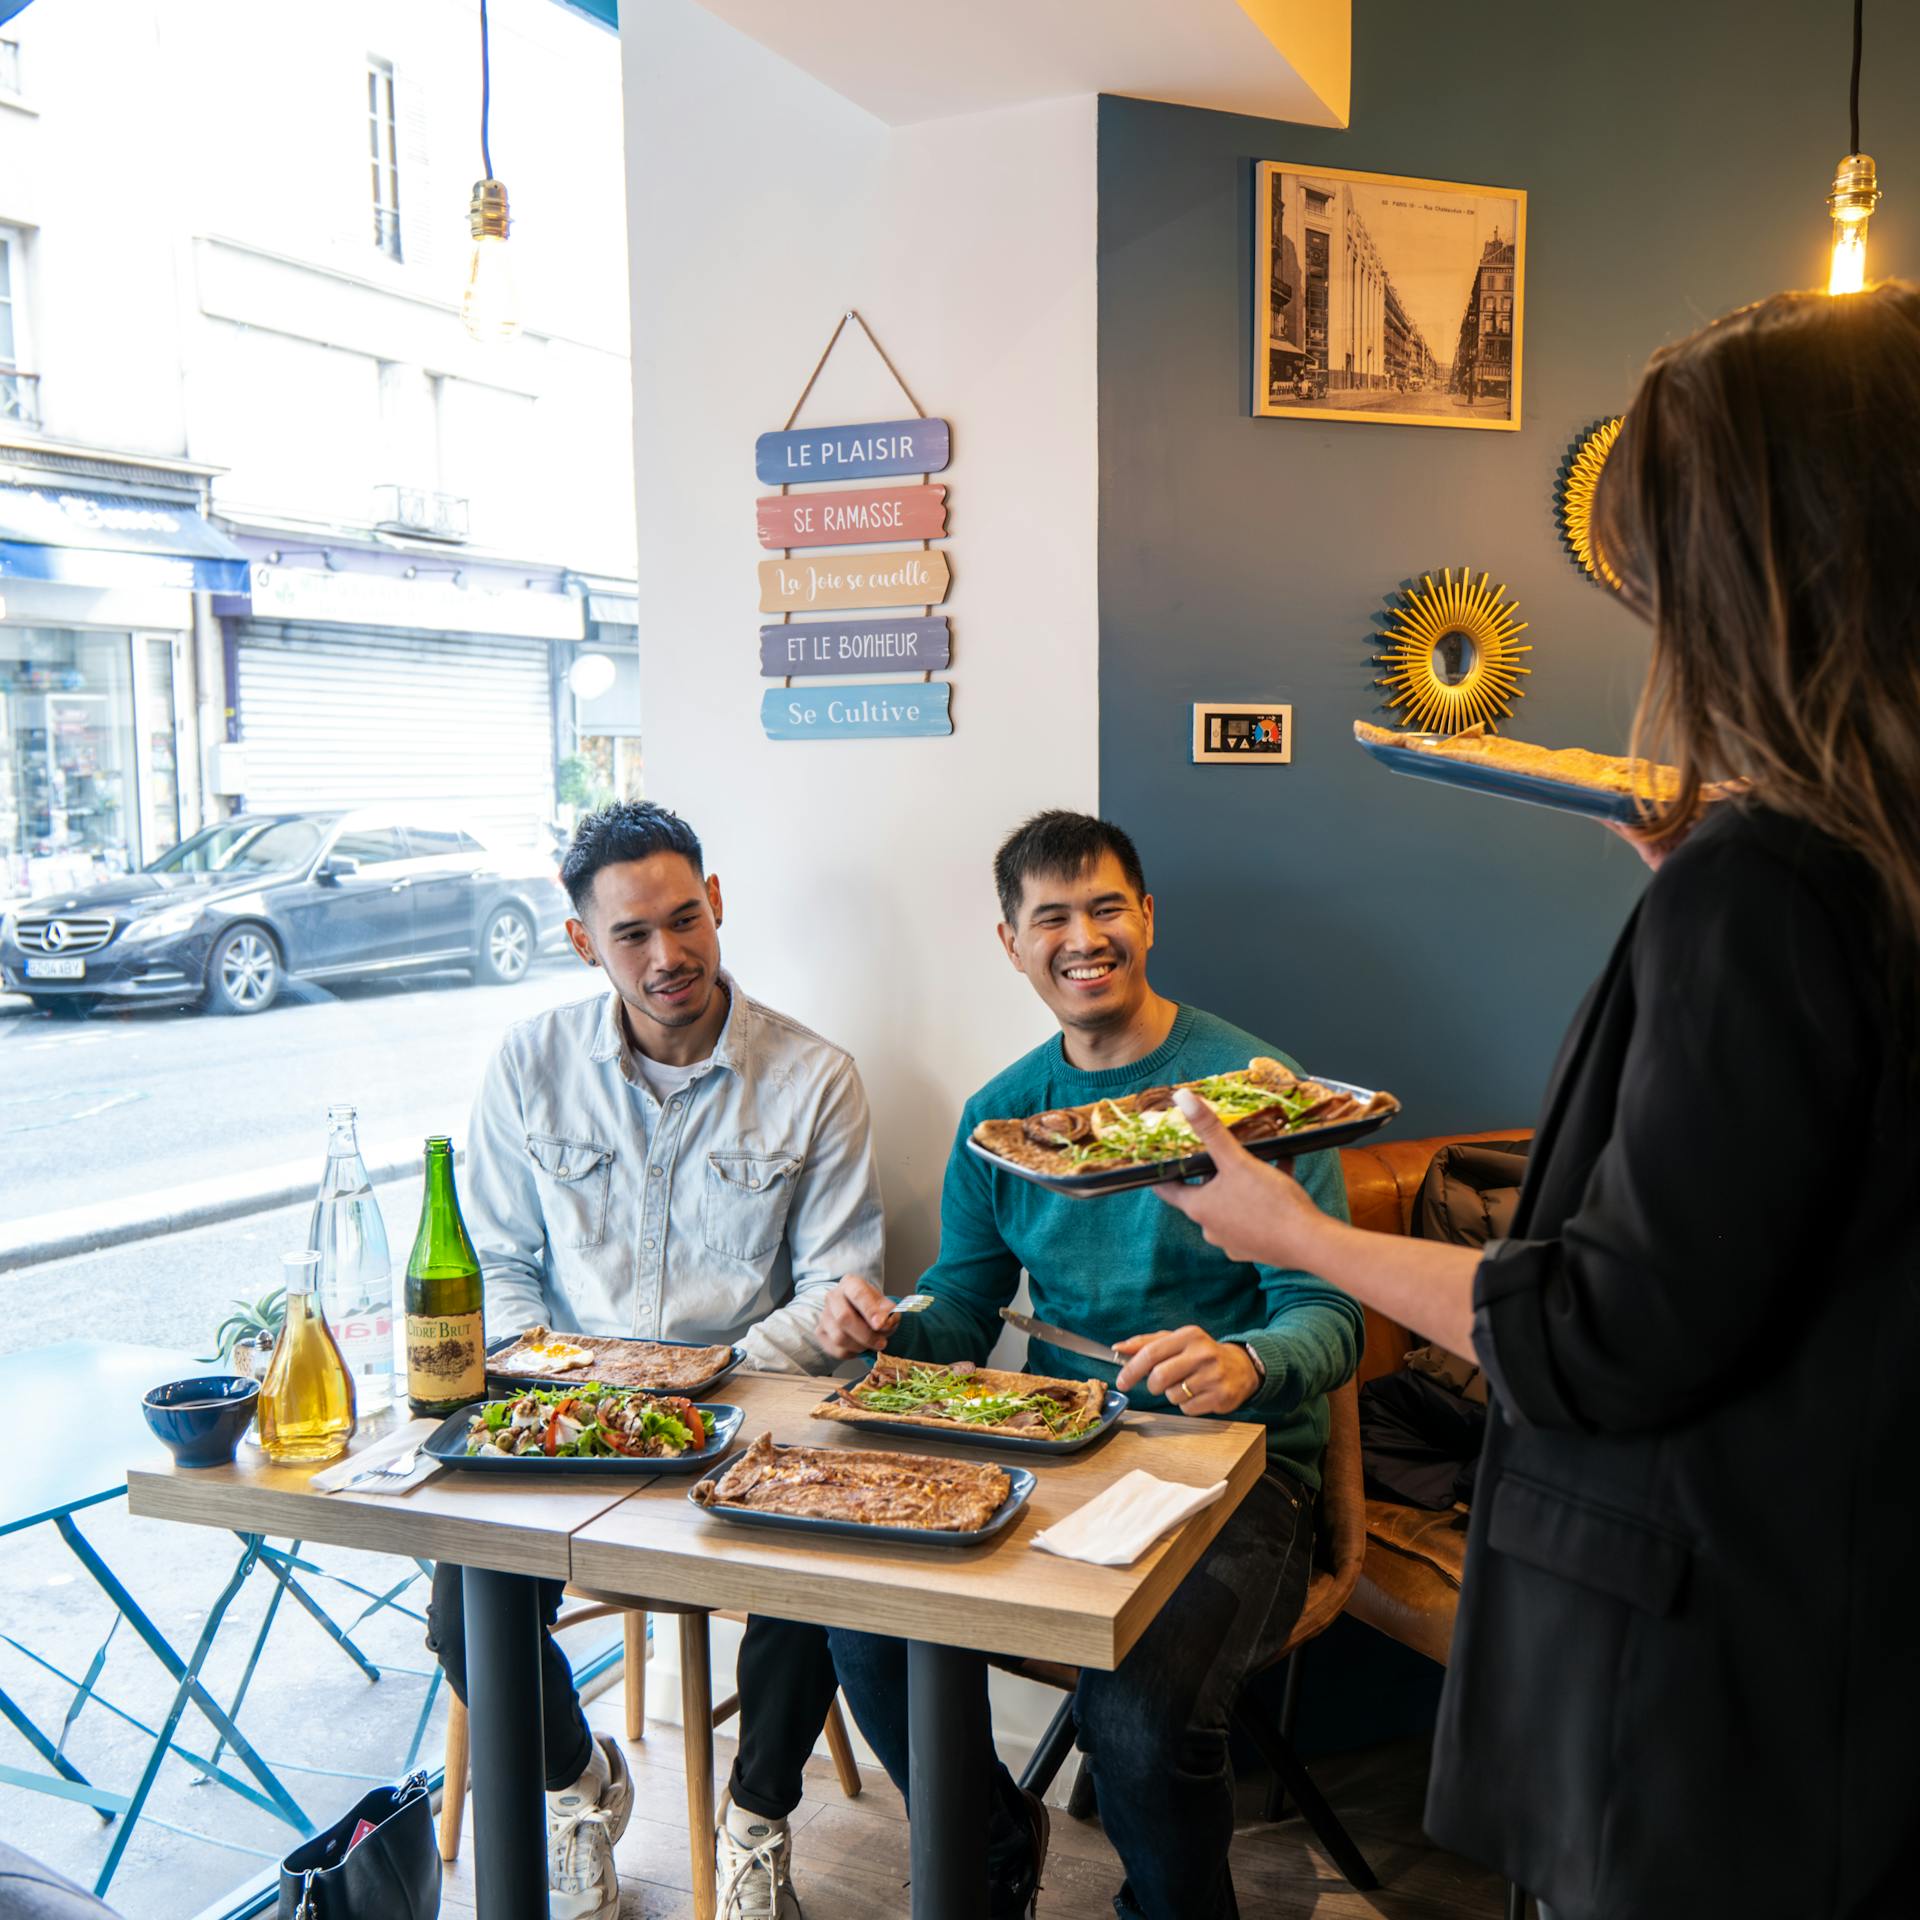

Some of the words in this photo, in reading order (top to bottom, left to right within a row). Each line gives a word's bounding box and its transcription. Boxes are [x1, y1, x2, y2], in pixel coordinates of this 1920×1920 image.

[787, 444, 812, 467] LE
[821, 436, 914, 465] PLAISIR
[793, 508, 814, 533] SE
[823, 502, 904, 531] RAMASSE
[775, 568, 800, 596] La
[799, 566, 842, 601] Joie
[846, 573, 865, 590] se
[868, 560, 930, 588] cueille
[787, 637, 807, 661] ET
[814, 636, 831, 660] LE
[838, 632, 918, 659] BONHEUR
[788, 702, 817, 725] Se
[827, 700, 920, 724] Cultive
[407, 1319, 437, 1338] CIDRE
